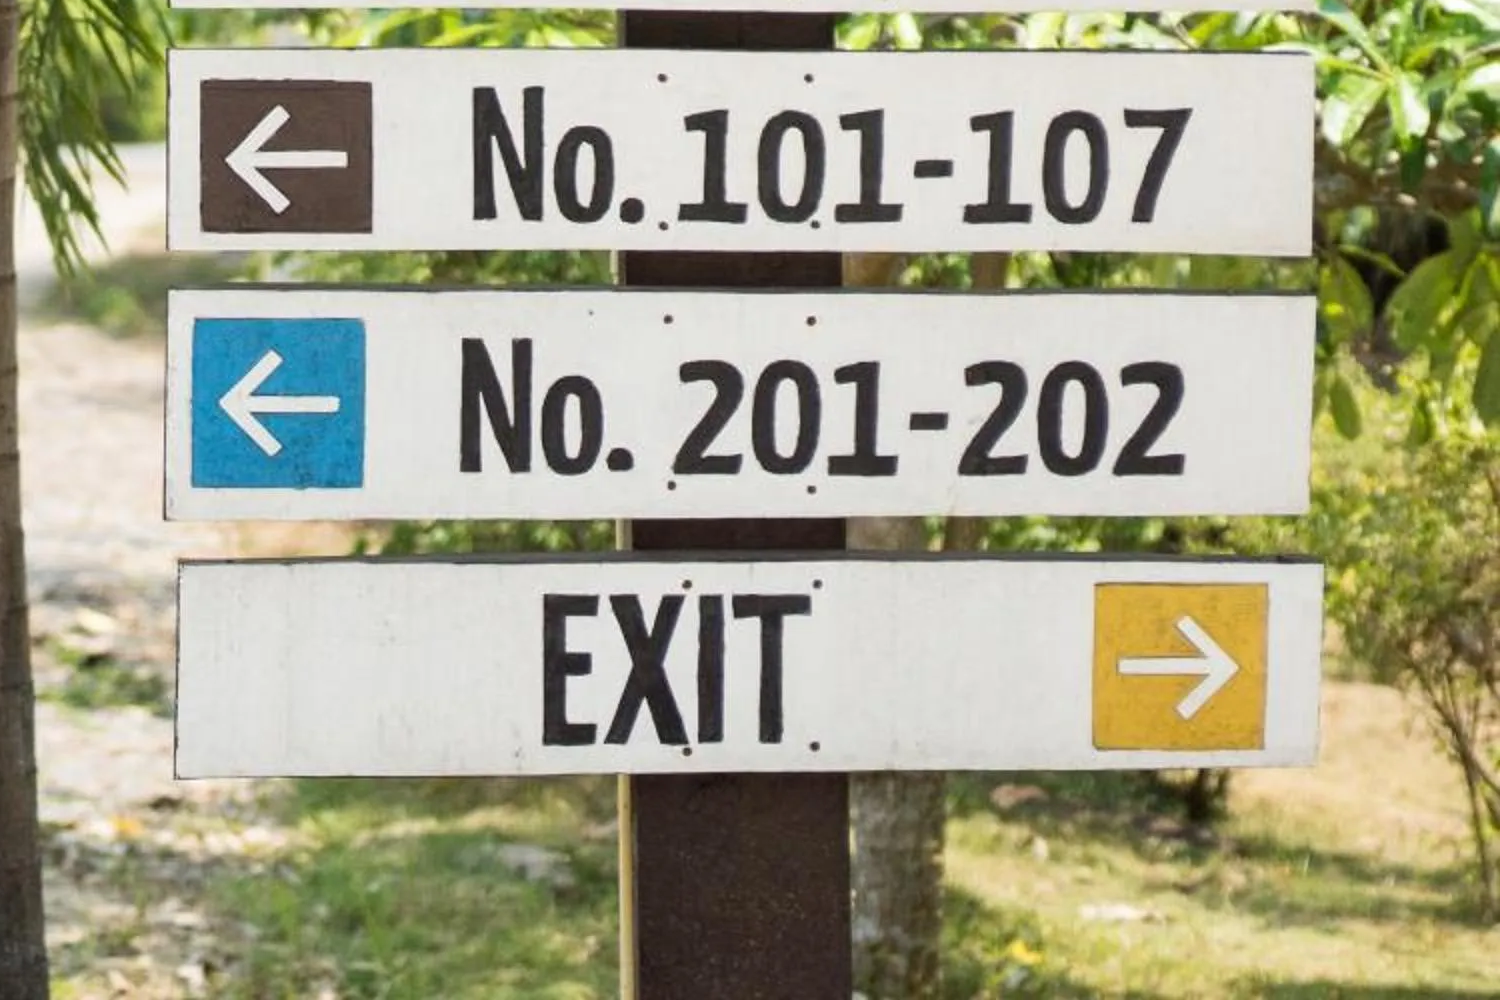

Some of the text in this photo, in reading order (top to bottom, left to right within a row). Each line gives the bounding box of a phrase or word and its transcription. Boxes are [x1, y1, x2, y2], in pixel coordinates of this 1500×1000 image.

[472, 86, 1192, 225] No. 101-107
[459, 337, 1185, 477] No. 201-202
[542, 593, 811, 747] EXIT
